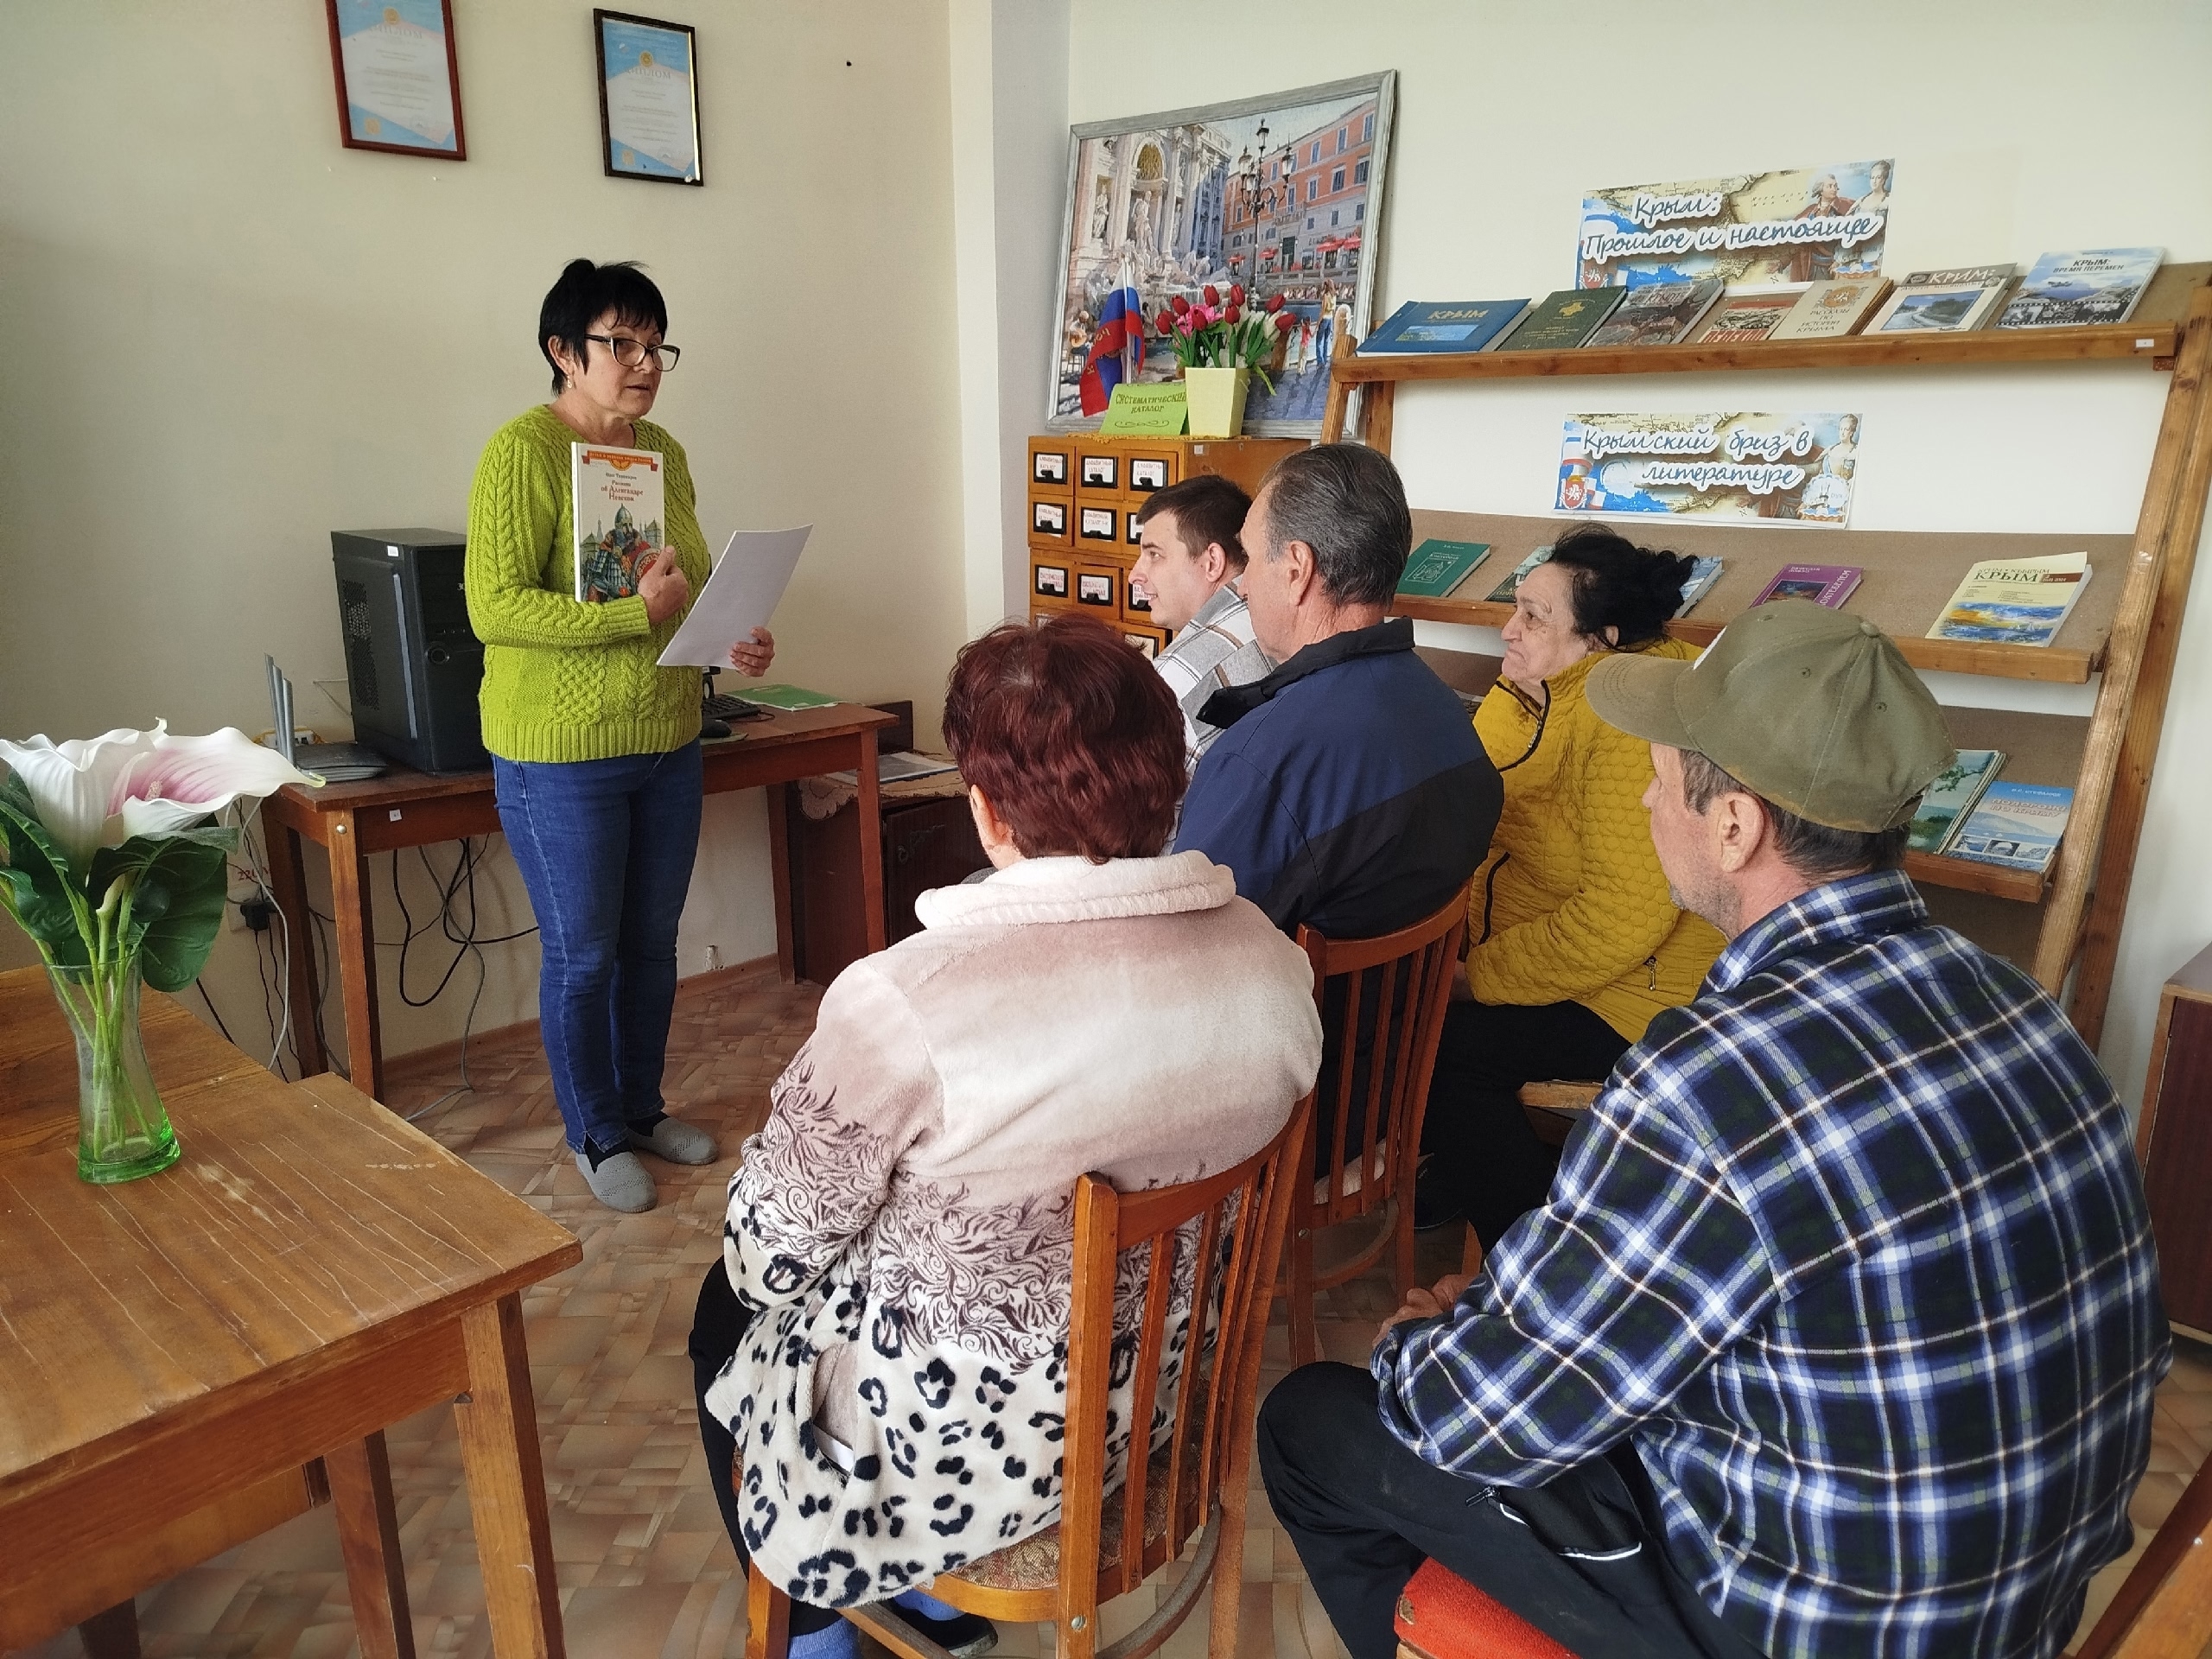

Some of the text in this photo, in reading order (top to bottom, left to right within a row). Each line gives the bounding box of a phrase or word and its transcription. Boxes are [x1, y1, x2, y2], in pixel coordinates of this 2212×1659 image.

[1635, 196, 1719, 224] Крым:
[1586, 213, 1877, 259] Прошлое и настоящее
[1427, 308, 1490, 320] КРЫМ
[1131, 405, 1164, 414] КАТАЛОГ
[1583, 428, 1809, 457] Крымский бриз в
[1642, 464, 1801, 490] литературе
[1819, 569, 1852, 605] ОКТЕБЕЛЕМ
[1974, 571, 2038, 582] КРЫМ
